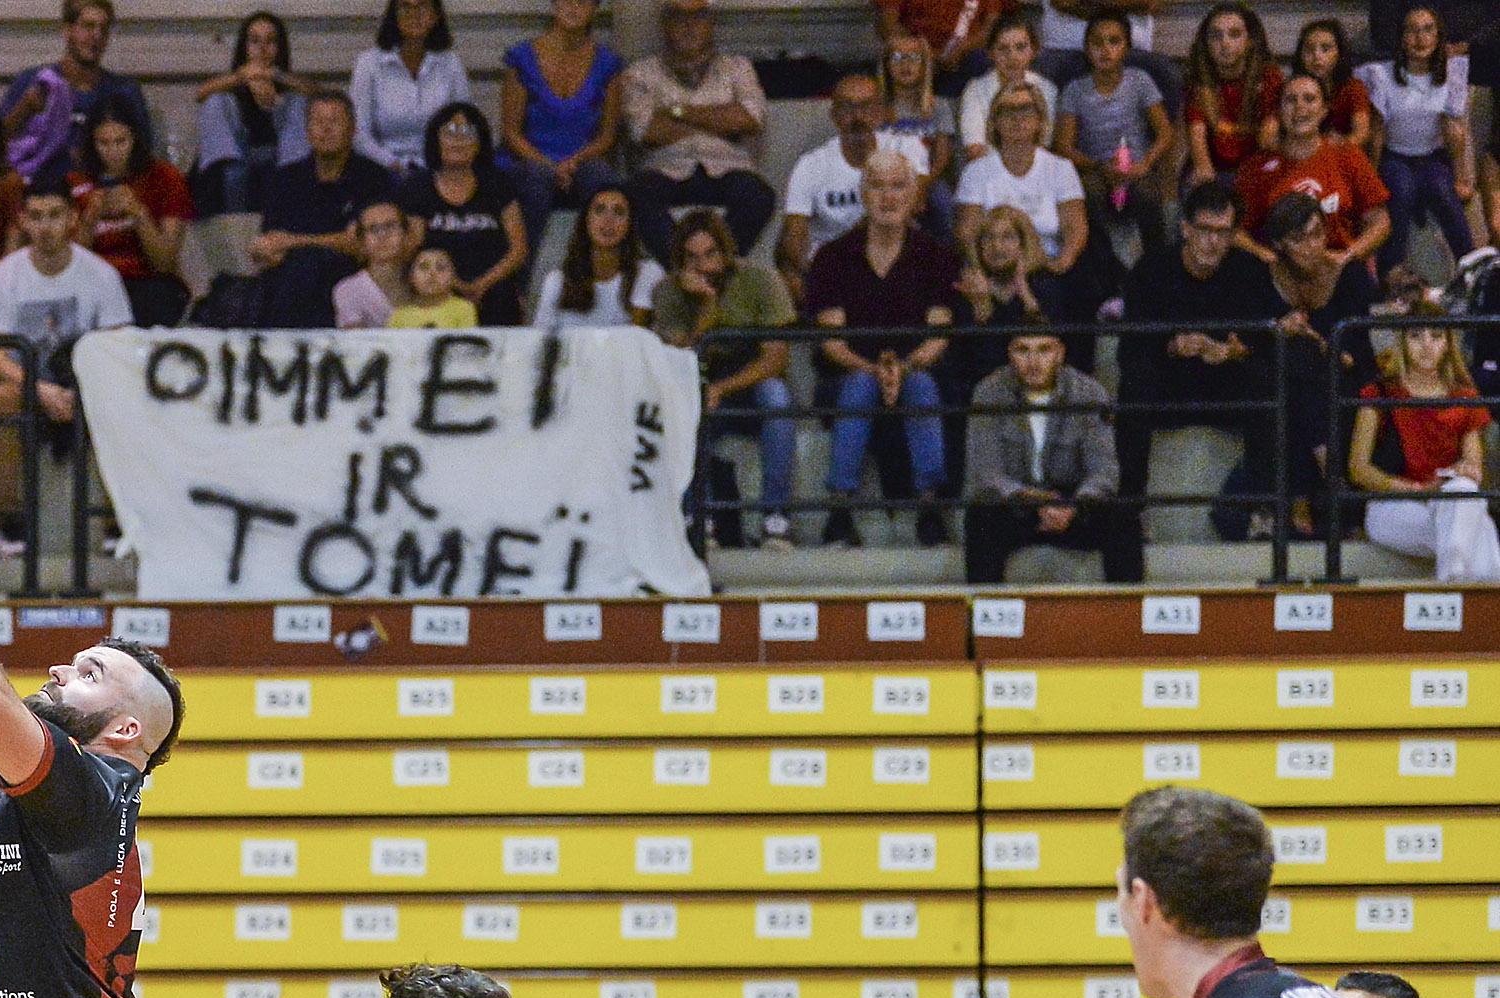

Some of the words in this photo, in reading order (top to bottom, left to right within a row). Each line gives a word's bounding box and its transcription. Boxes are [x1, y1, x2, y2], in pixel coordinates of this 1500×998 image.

[343, 443, 440, 520] IR
[107, 889, 119, 928] PAOLA
[115, 842, 126, 874] LUCIA
